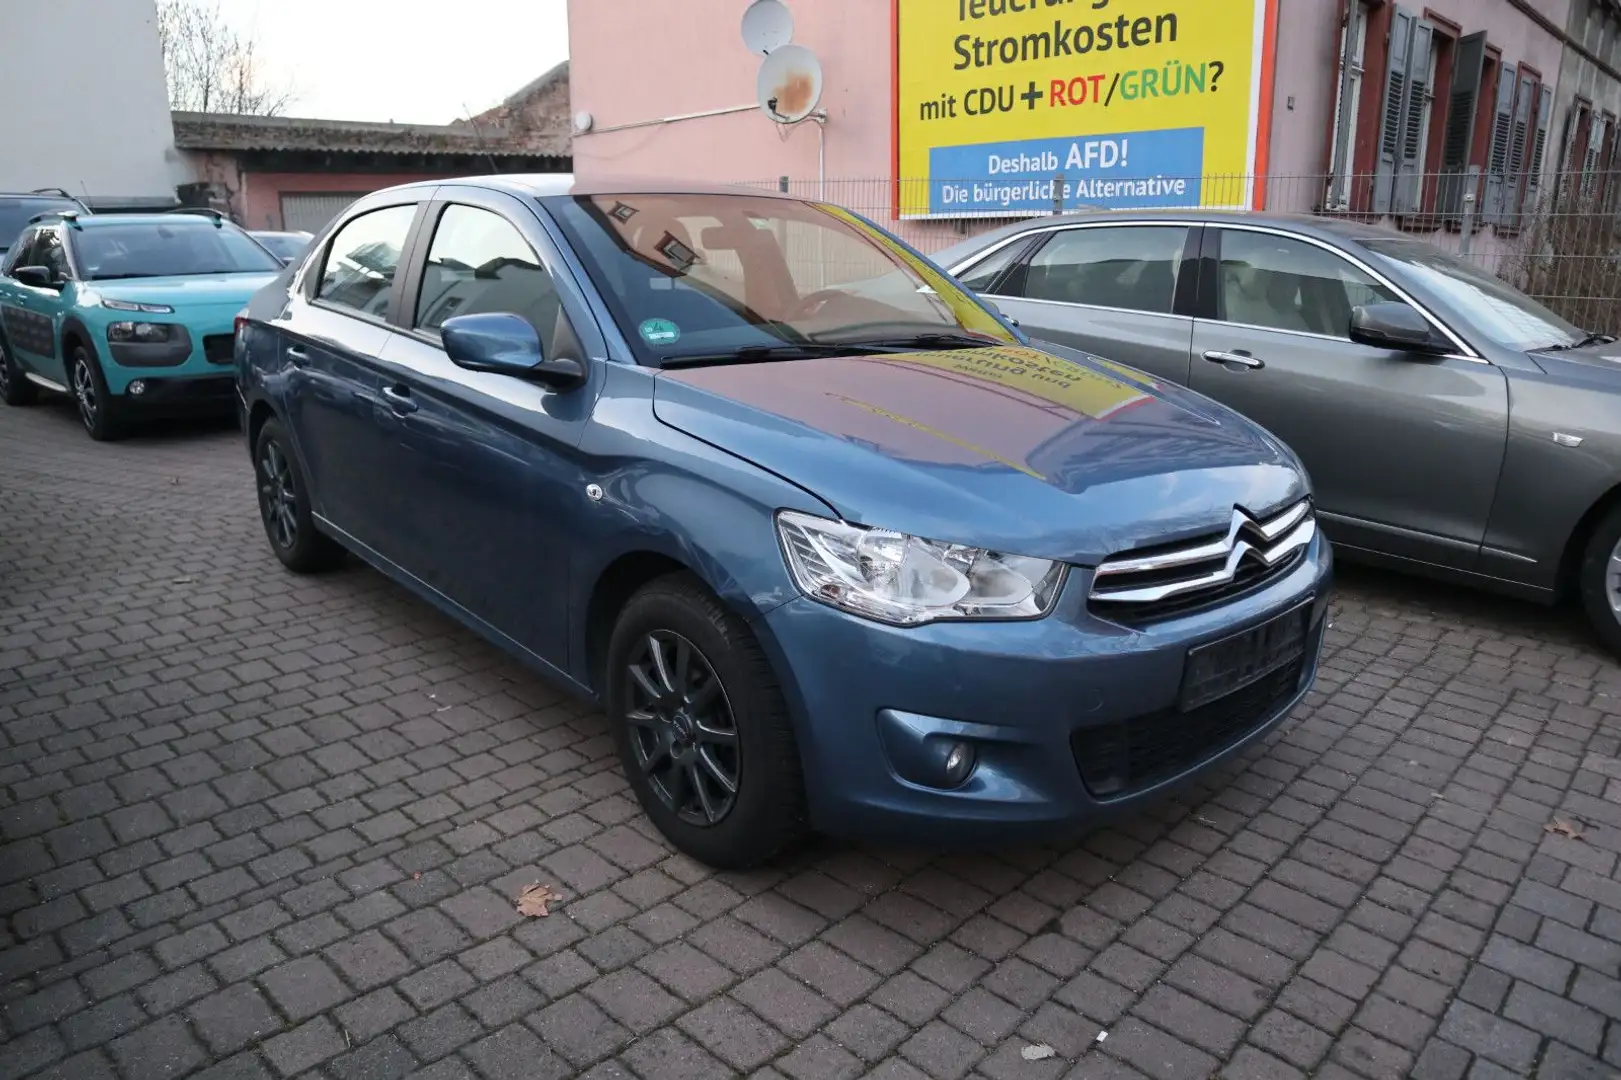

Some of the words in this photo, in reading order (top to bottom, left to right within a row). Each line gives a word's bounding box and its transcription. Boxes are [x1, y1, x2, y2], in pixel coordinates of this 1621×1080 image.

[953, 12, 1178, 70] Stromkosten
[920, 93, 957, 120] mit
[963, 84, 1014, 116] CDU
[1020, 81, 1044, 110] +
[988, 151, 1059, 175] Deshalb
[1064, 138, 1129, 170] AFD!
[942, 184, 969, 204] Die
[1076, 174, 1186, 199] Alternative
